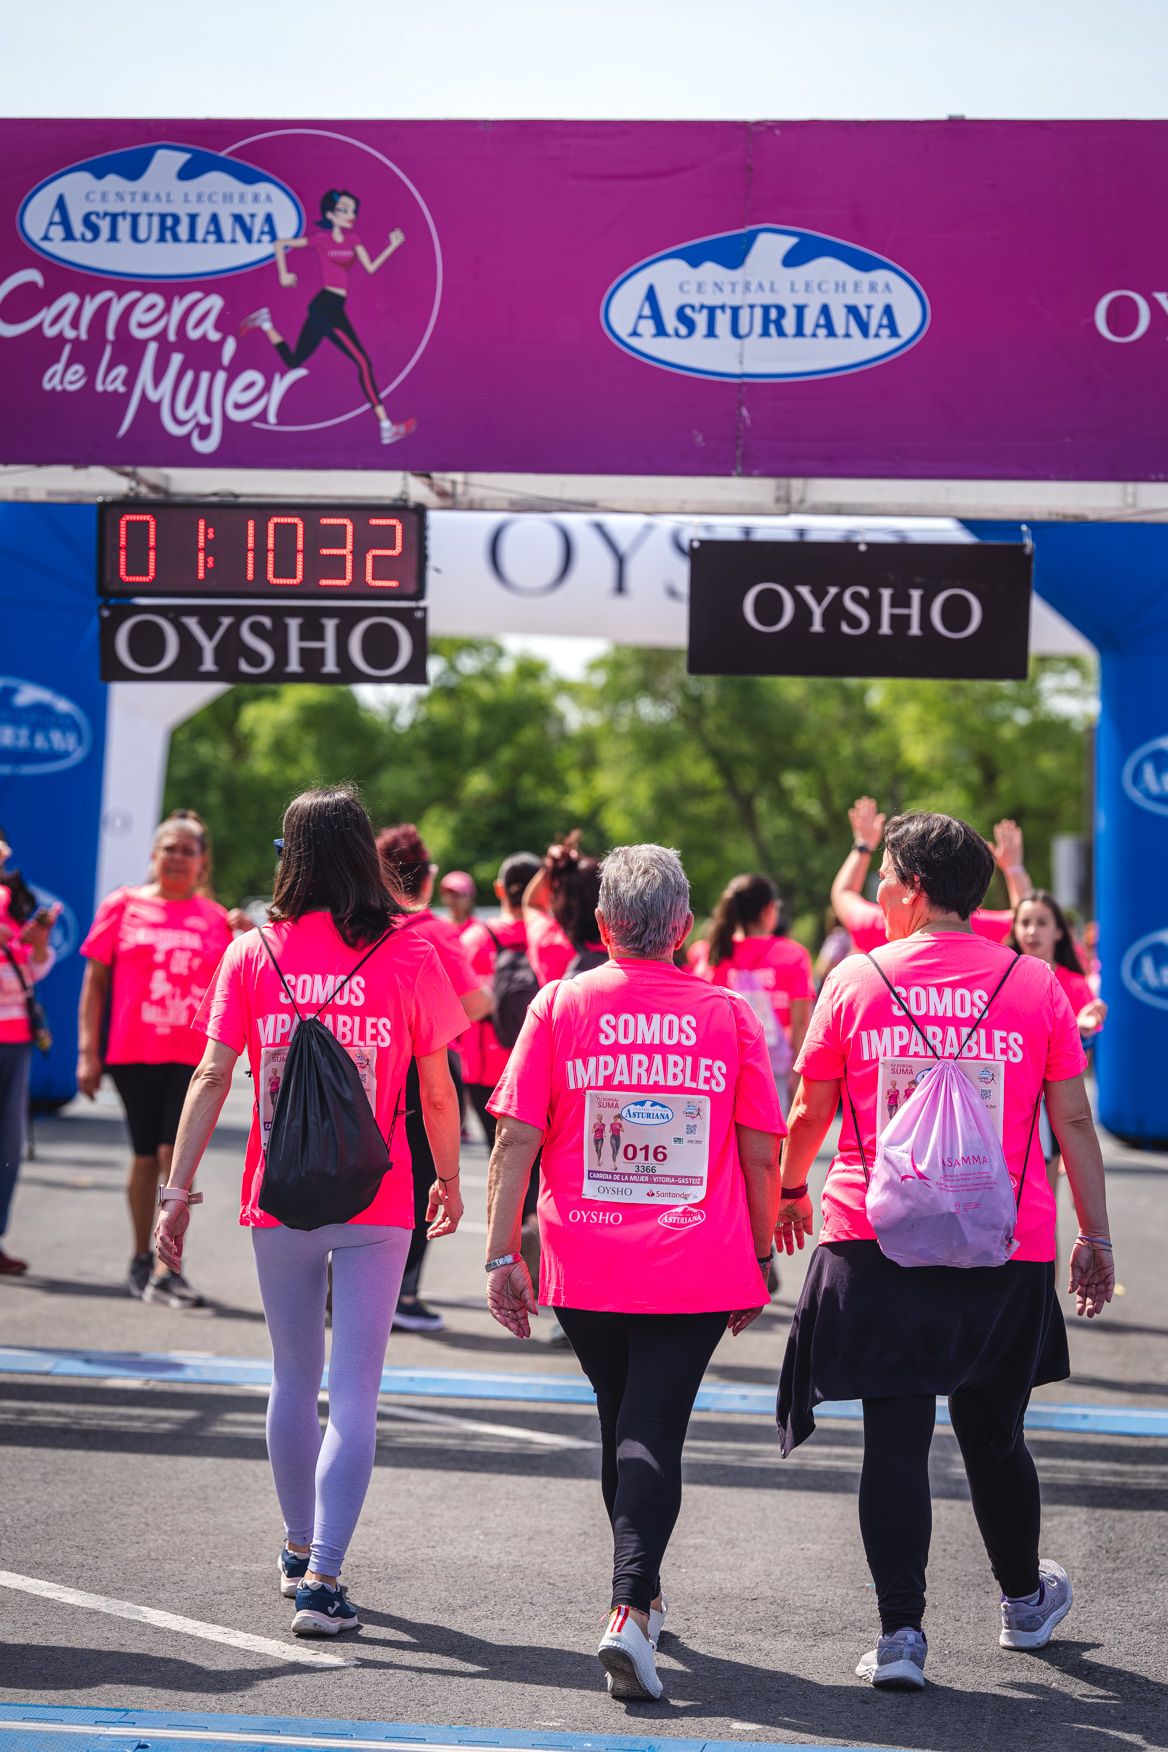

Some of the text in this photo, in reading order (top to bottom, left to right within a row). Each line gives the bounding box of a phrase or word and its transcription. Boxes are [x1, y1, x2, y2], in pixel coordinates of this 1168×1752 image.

[85, 190, 274, 205] CENTRAL LECHERA
[40, 193, 279, 244] ASTURIANA
[678, 279, 893, 294] CENTRAL LECHERA
[0, 267, 225, 343] Carrera
[628, 283, 902, 339] ASTURIANA
[1094, 289, 1168, 343] O
[42, 336, 309, 454] de la Mujer
[742, 582, 983, 639] OYSHO
[114, 613, 414, 677] OYSHO
[278, 973, 366, 1007] SOMOS
[890, 985, 989, 1020] SOMOS
[598, 1013, 697, 1047] SOMOS
[859, 1025, 1024, 1064] IMPARABLES
[565, 1053, 727, 1094] IMPARABLES
[625, 1107, 670, 1121] ASTURIANA
[623, 1143, 668, 1163] 016
[634, 1165, 657, 1174] 3366
[589, 1172, 612, 1181] CARRERA
[597, 1186, 633, 1197] OYSHO
[655, 1190, 691, 1200] Santander
[569, 1209, 623, 1225] OYSHO
